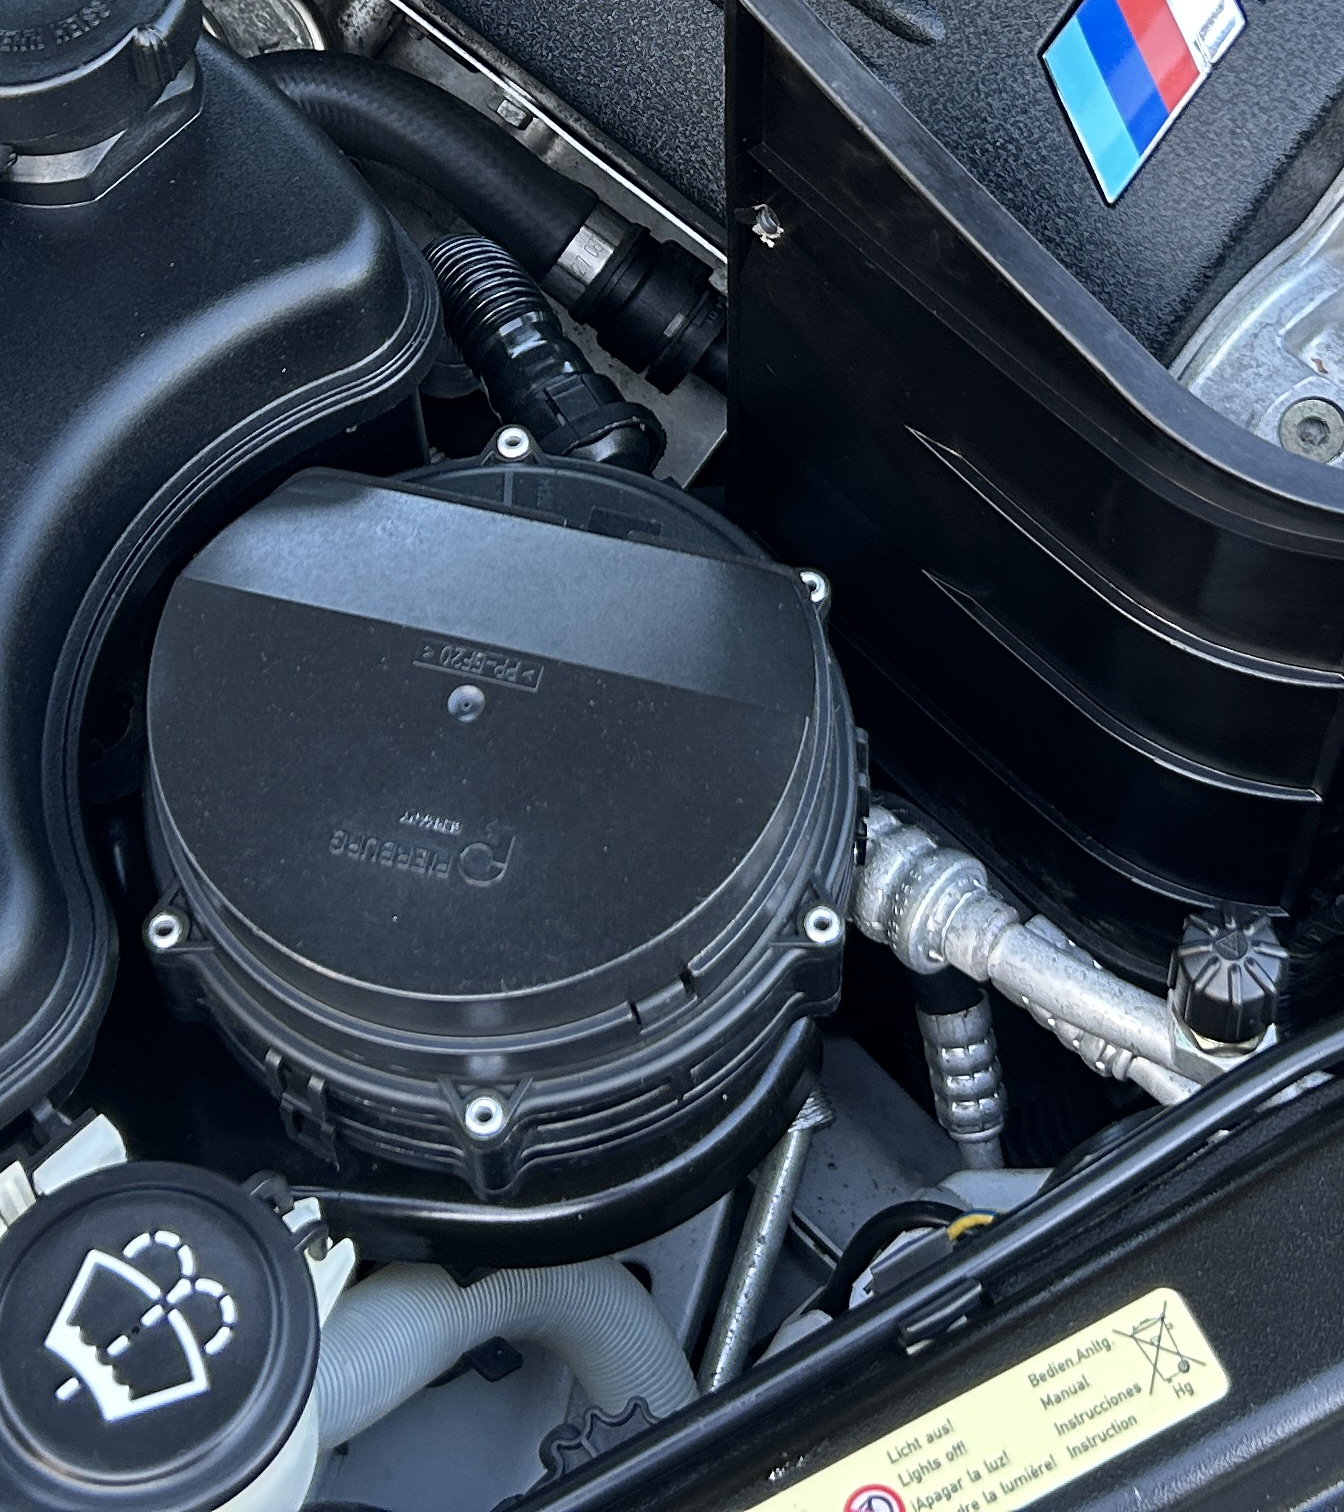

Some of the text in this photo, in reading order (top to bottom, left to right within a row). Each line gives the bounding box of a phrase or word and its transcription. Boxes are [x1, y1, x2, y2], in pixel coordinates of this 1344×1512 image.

[329, 829, 454, 880] PIERBURG
[1040, 1374, 1091, 1411] Manual
[1053, 1381, 1143, 1437] Instrucciones
[1171, 1380, 1195, 1400] Hg
[886, 1417, 955, 1465] Licht aus!
[1066, 1413, 1139, 1460] Instruction
[897, 1439, 969, 1489] Lights off!
[965, 1464, 983, 1482] la
[984, 1449, 1012, 1474] luz!
[981, 1488, 999, 1505] la
[1000, 1453, 1059, 1496] lumière!
